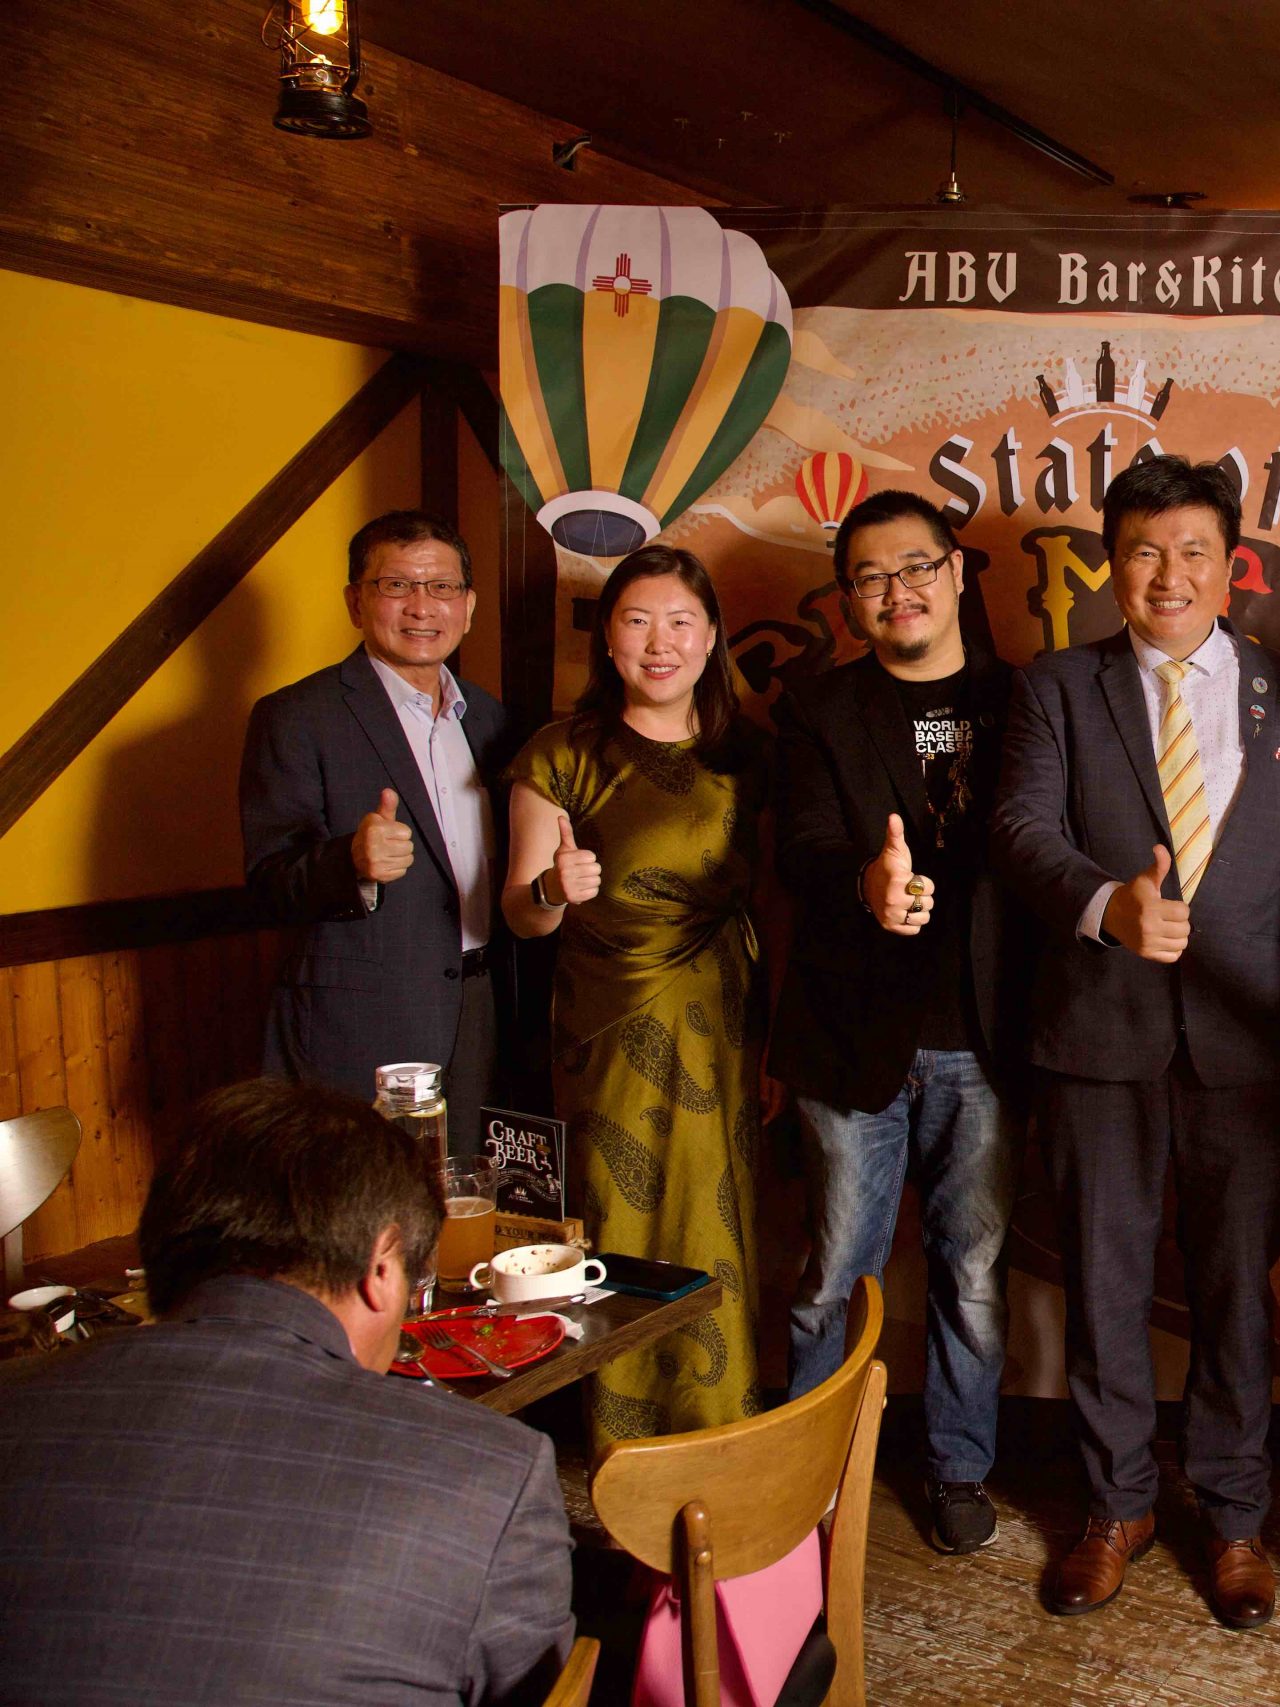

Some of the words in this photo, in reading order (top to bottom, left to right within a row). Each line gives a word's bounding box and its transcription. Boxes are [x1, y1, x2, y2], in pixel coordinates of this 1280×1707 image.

[913, 720, 971, 731] WORLD
[488, 1120, 547, 1148] CRAFT
[485, 1139, 543, 1170] BEER
